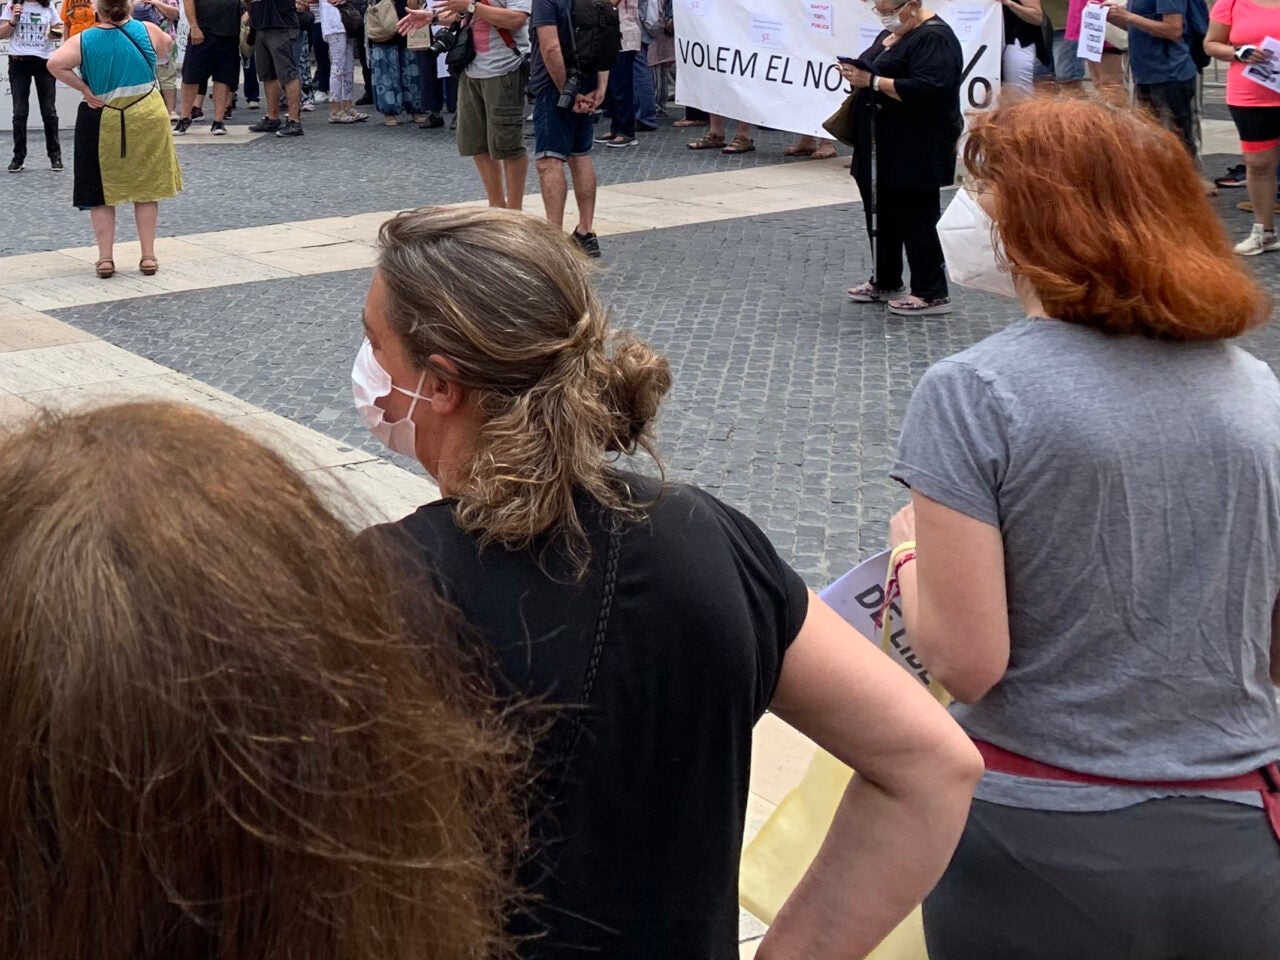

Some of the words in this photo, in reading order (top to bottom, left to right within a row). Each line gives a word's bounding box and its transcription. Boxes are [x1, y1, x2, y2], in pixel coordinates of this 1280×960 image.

[678, 38, 759, 79] VOLEM
[765, 54, 794, 85] EL
[803, 60, 853, 95] NO
